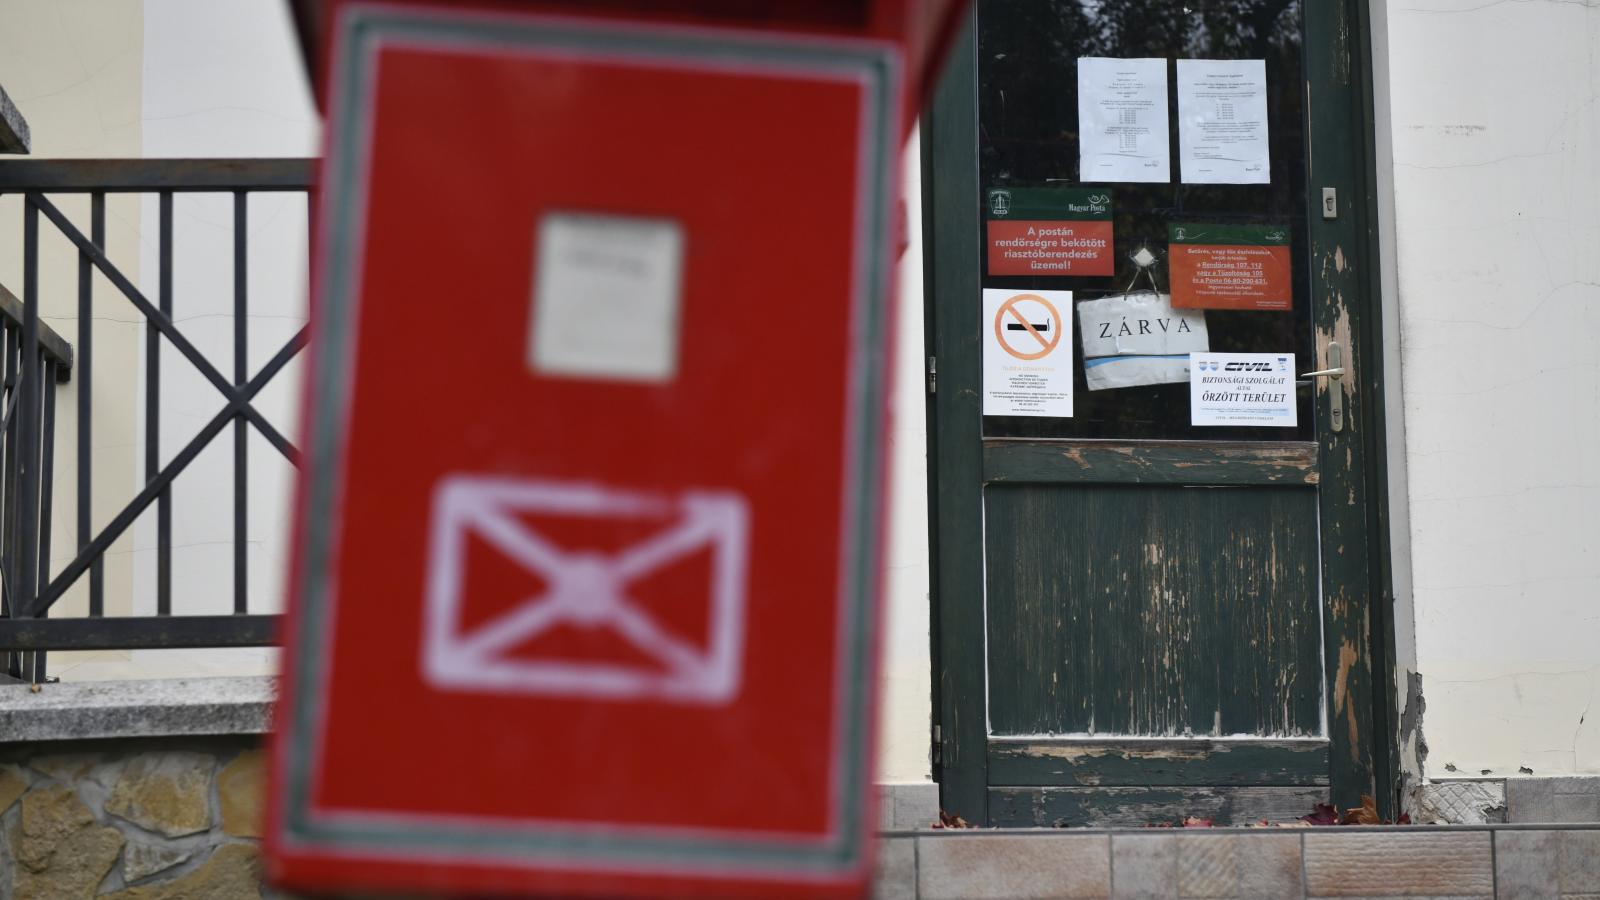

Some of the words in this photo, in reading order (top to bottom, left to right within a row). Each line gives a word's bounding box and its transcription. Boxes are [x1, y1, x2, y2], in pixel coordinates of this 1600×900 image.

[1068, 204, 1089, 212] Magyar
[1090, 204, 1106, 212] Posta
[1027, 227, 1036, 236] A
[1039, 227, 1073, 238] postán
[995, 238, 1057, 249] rendőrségre
[1061, 238, 1106, 248] bekötött
[1004, 249, 1098, 259] riasztóberendezés
[1031, 260, 1071, 270] üzemel!
[1099, 316, 1192, 339] ZÁRVA
[1225, 362, 1273, 372] CIVIL
[1201, 375, 1245, 384] BIZTONSÁGI
[1245, 376, 1286, 385] SZOLGÁLAT
[1202, 390, 1241, 402] ŐRZÖTT
[1242, 391, 1287, 403] TERÜLET
